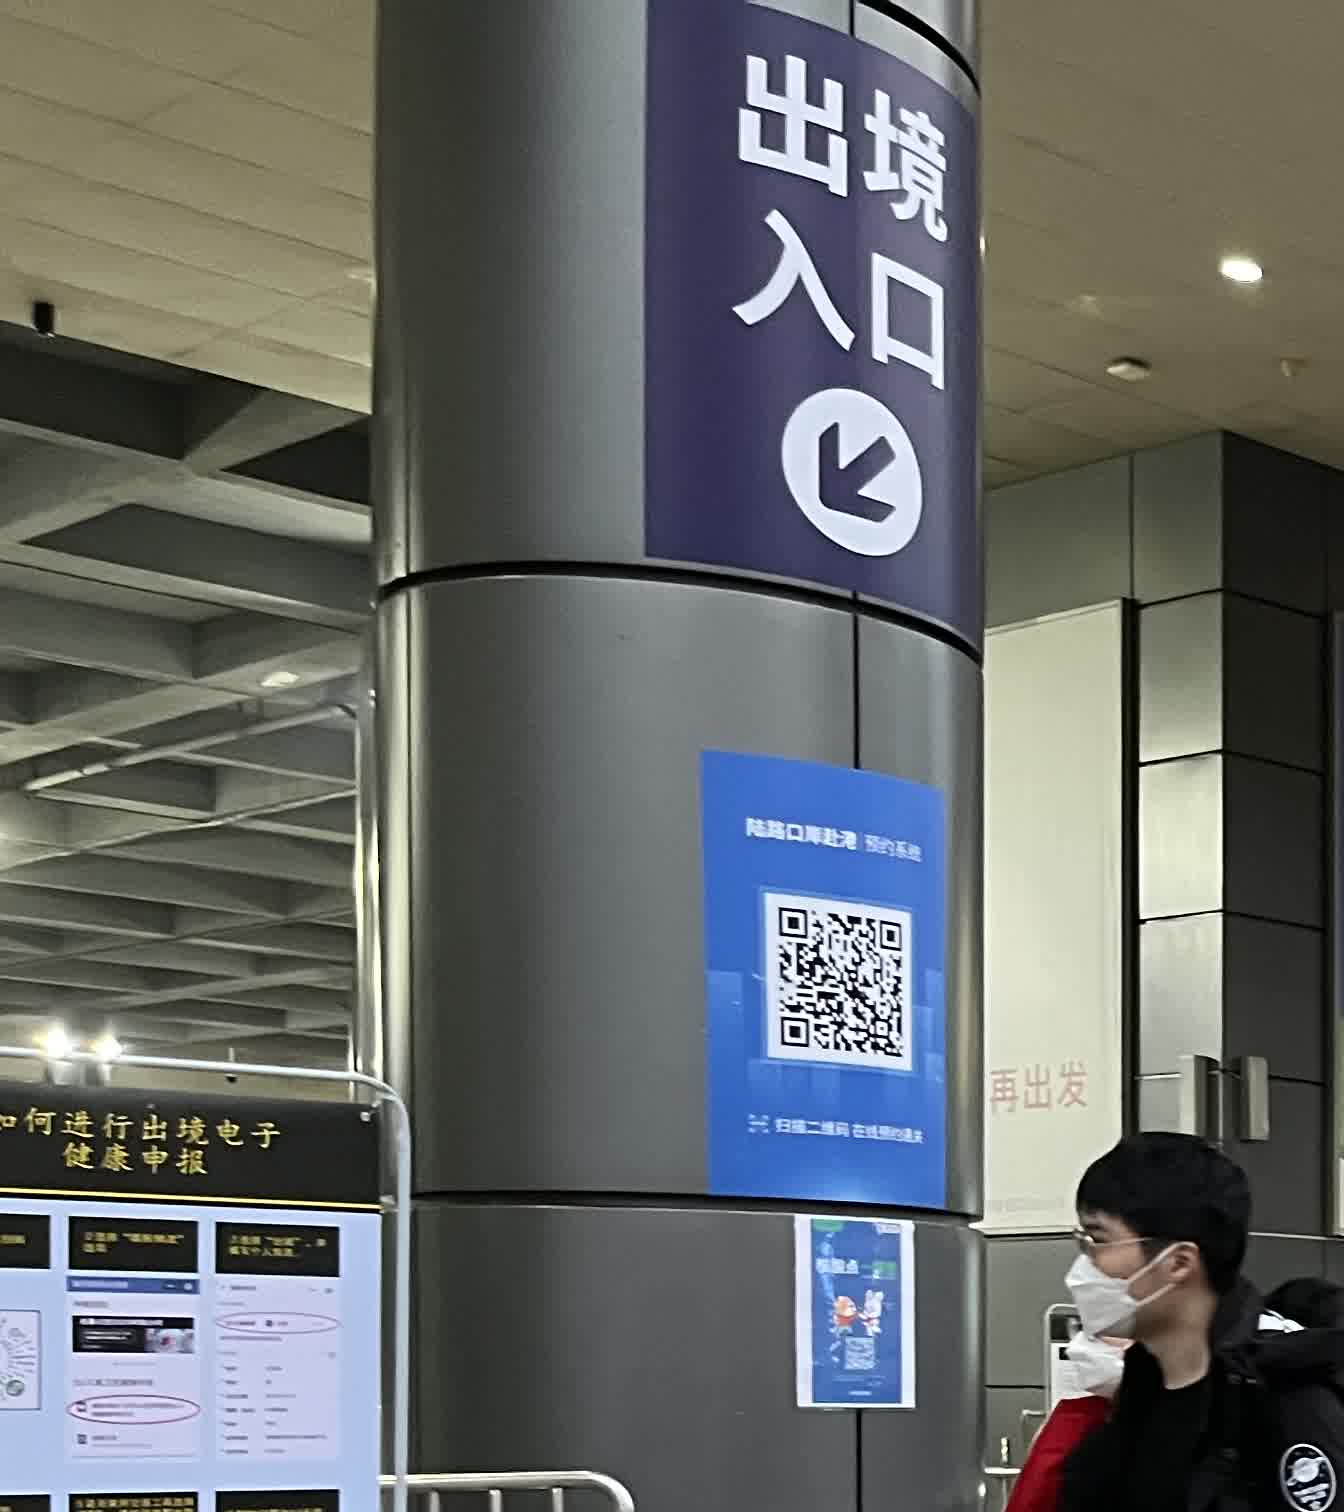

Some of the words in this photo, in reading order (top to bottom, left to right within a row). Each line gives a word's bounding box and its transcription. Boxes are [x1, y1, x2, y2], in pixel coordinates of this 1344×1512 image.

[738, 54, 949, 243] 出境
[732, 209, 946, 389] 入口
[62, 1142, 209, 1175] 健康申报
